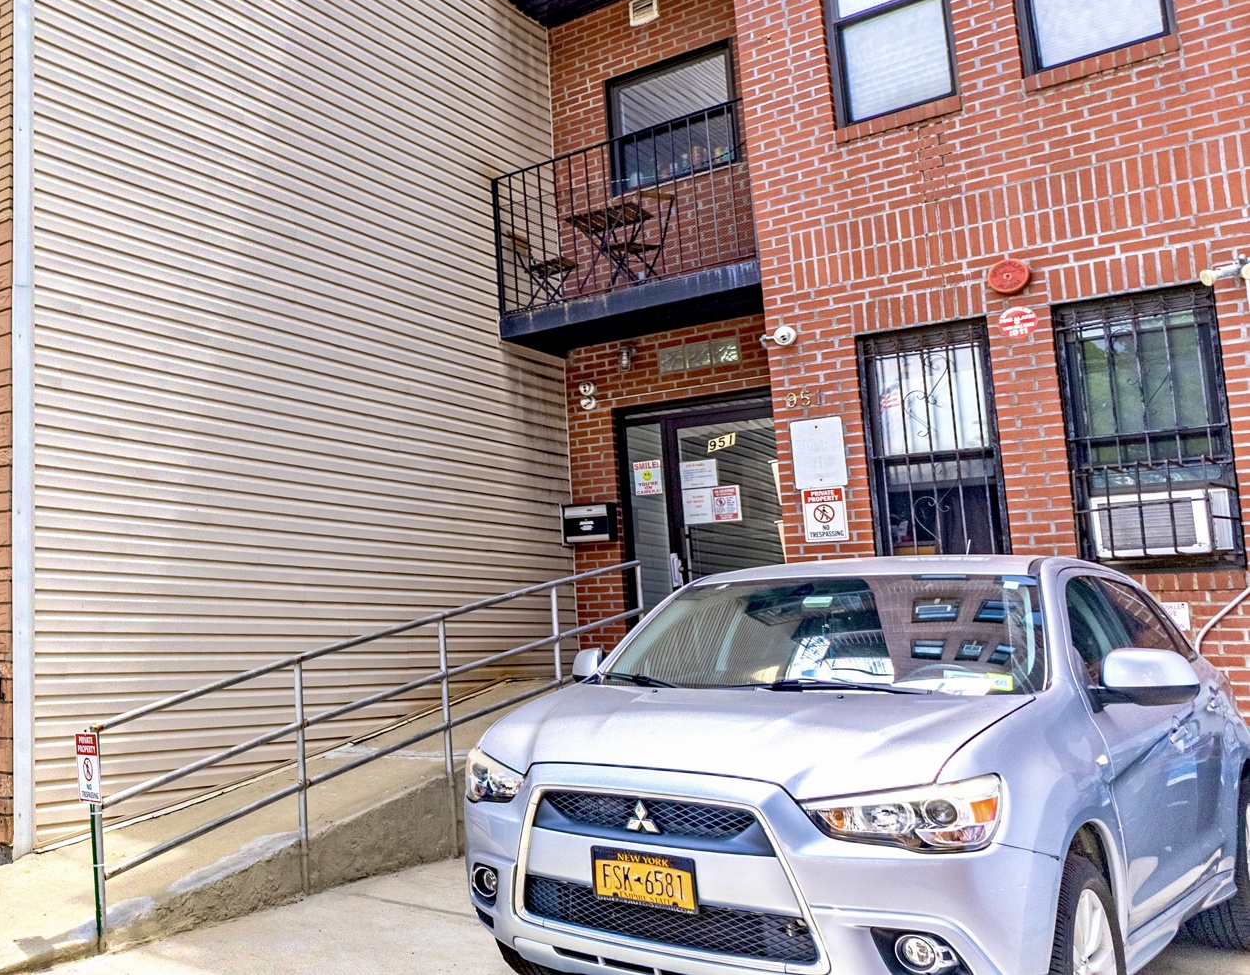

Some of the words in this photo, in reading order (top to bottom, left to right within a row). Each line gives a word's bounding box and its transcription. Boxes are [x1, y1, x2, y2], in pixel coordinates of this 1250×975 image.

[786, 388, 823, 408] 951
[709, 434, 733, 451] 951
[634, 461, 659, 471] SMILE!
[810, 489, 835, 497] PRIVATE
[810, 530, 844, 538] TRESPASSING
[78, 736, 94, 744] PRIVATE
[77, 744, 96, 754] PROPERTY
[617, 853, 640, 863] NEW
[642, 856, 669, 868] YORK
[619, 891, 646, 901] EMPIRE
[650, 896, 671, 905] STATE
